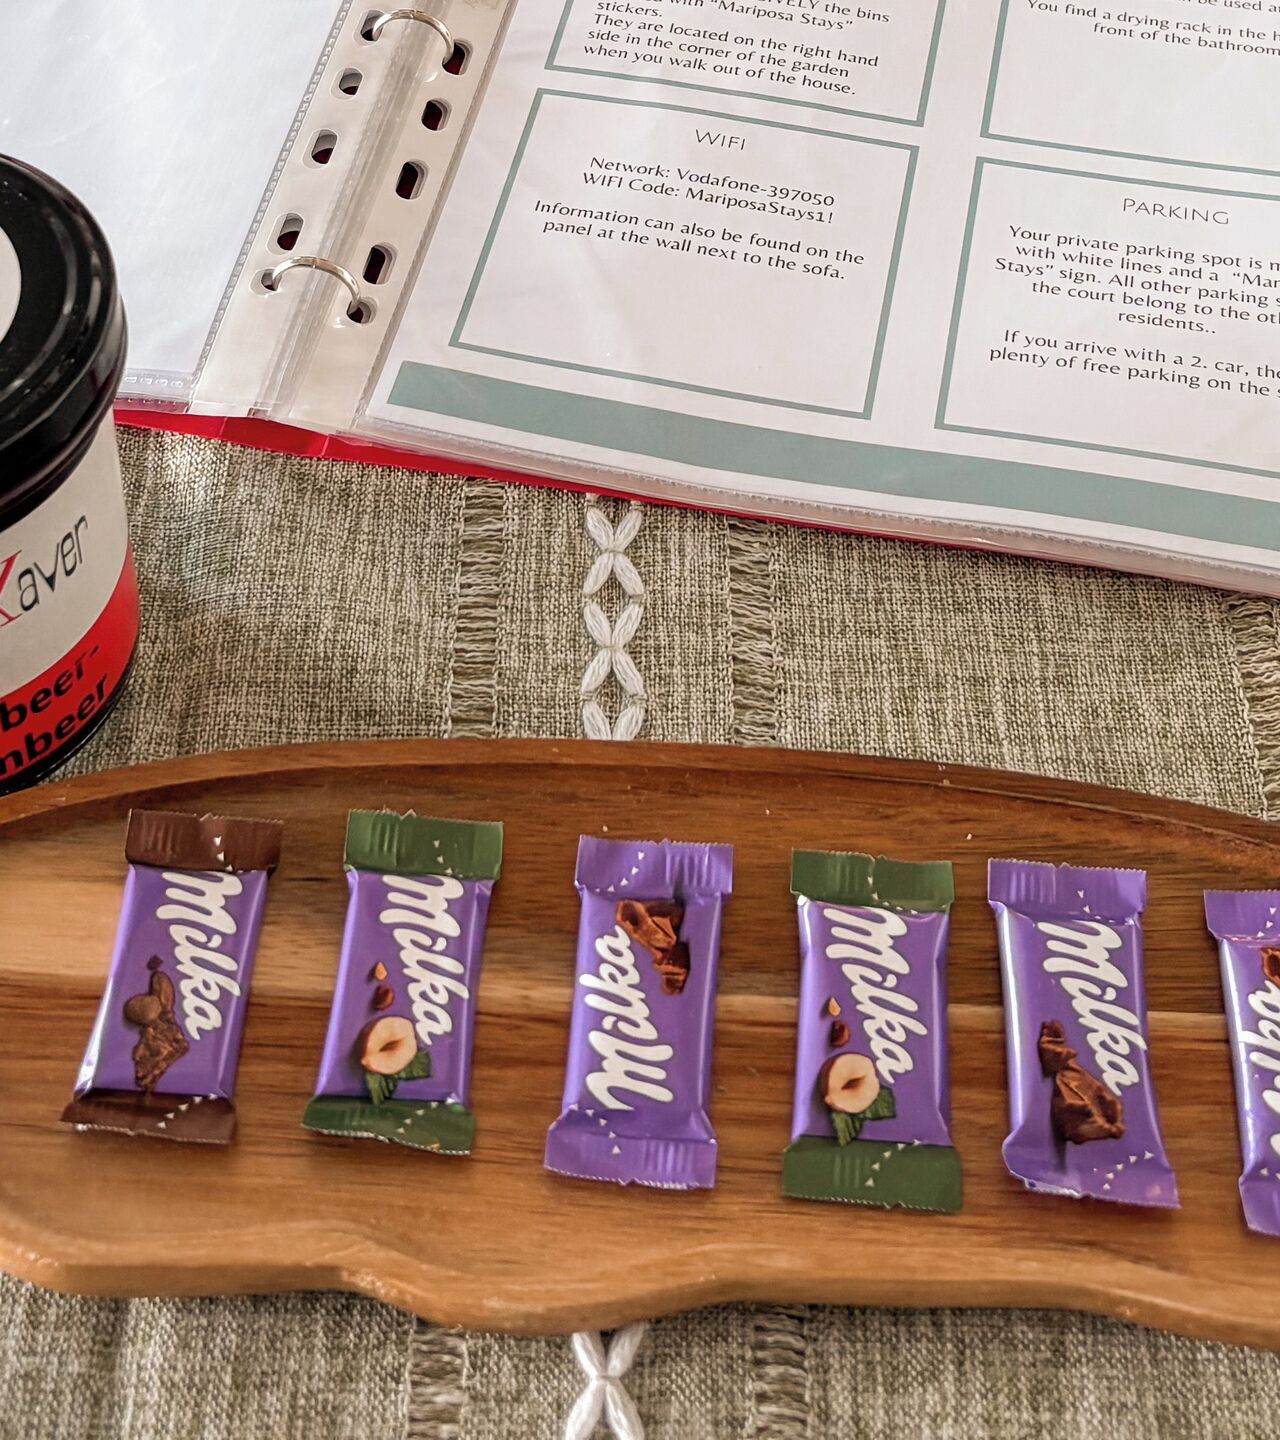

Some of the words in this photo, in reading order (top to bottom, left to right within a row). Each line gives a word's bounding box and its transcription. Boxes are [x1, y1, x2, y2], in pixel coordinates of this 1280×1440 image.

[596, 1, 663, 18] stickers.
[824, 2, 852, 16] the
[856, 6, 890, 23] bins
[1223, 0, 1263, 12] used
[588, 29, 622, 43] side
[625, 32, 641, 46] in
[646, 35, 674, 50] the
[678, 42, 730, 59] corner
[736, 50, 755, 62] of
[759, 52, 788, 68] the
[790, 59, 850, 78] garden
[595, 13, 635, 30] They
[636, 21, 665, 33] are
[668, 22, 730, 43] located
[733, 35, 755, 47] on
[760, 37, 788, 52] the
[792, 43, 833, 60] right
[837, 48, 879, 68] hand
[1093, 22, 1135, 38] front
[1140, 30, 1158, 41] of
[1164, 32, 1192, 46] the
[583, 43, 630, 60] when
[630, 51, 664, 65] you
[668, 56, 707, 72] walk
[712, 64, 741, 76] out
[744, 67, 765, 80] of
[769, 70, 797, 85] the
[801, 74, 856, 96] house.
[695, 128, 746, 151] WIFI
[582, 171, 624, 189] WIFI
[628, 178, 681, 198] Code:
[685, 186, 834, 224] MariposaStays1!
[589, 156, 671, 182] Network:
[676, 167, 835, 207] Vodafone-397050
[534, 199, 640, 226] Information
[644, 218, 675, 232] can
[679, 222, 716, 239] also
[720, 227, 744, 244] be
[748, 232, 802, 254] found
[805, 246, 829, 260] on
[835, 248, 865, 265] the
[1122, 197, 1229, 225] PARKING
[1009, 224, 1052, 243] Your
[1056, 234, 1120, 252] private
[1125, 244, 1196, 265] parking
[1201, 253, 1242, 268] spot
[1248, 256, 1263, 270] is
[1015, 245, 1056, 261] with
[1061, 250, 1115, 268] white
[1120, 256, 1163, 275] lines
[1168, 266, 1203, 280] and
[1208, 271, 1220, 282] a
[1032, 280, 1062, 296] the
[1066, 287, 1116, 303] court
[1122, 290, 1188, 315] belong
[1192, 303, 1214, 316] to
[1219, 304, 1251, 321] the
[1058, 267, 1102, 285] sign.
[1107, 273, 1135, 289] All
[1140, 278, 1193, 296] other
[1197, 287, 1270, 309] parking
[1118, 312, 1216, 334] residents..
[989, 346, 1050, 366] plenty
[1055, 355, 1079, 369] of
[1082, 357, 1122, 375] free
[1127, 366, 1201, 390] parking
[1206, 378, 1232, 391] on
[1238, 379, 1271, 397] the
[1004, 328, 1021, 344] If
[1022, 335, 1058, 349] you
[1063, 340, 1118, 357] arrive
[1123, 347, 1167, 364] with
[1172, 355, 1184, 366] a
[1190, 355, 1208, 370] 2.
[1214, 361, 1250, 377] car,
[156, 871, 243, 1040] Milka
[379, 874, 470, 1045] Milka
[578, 924, 674, 1111] Milka
[823, 907, 928, 1084] Milka
[1037, 921, 1147, 1094] Milka
